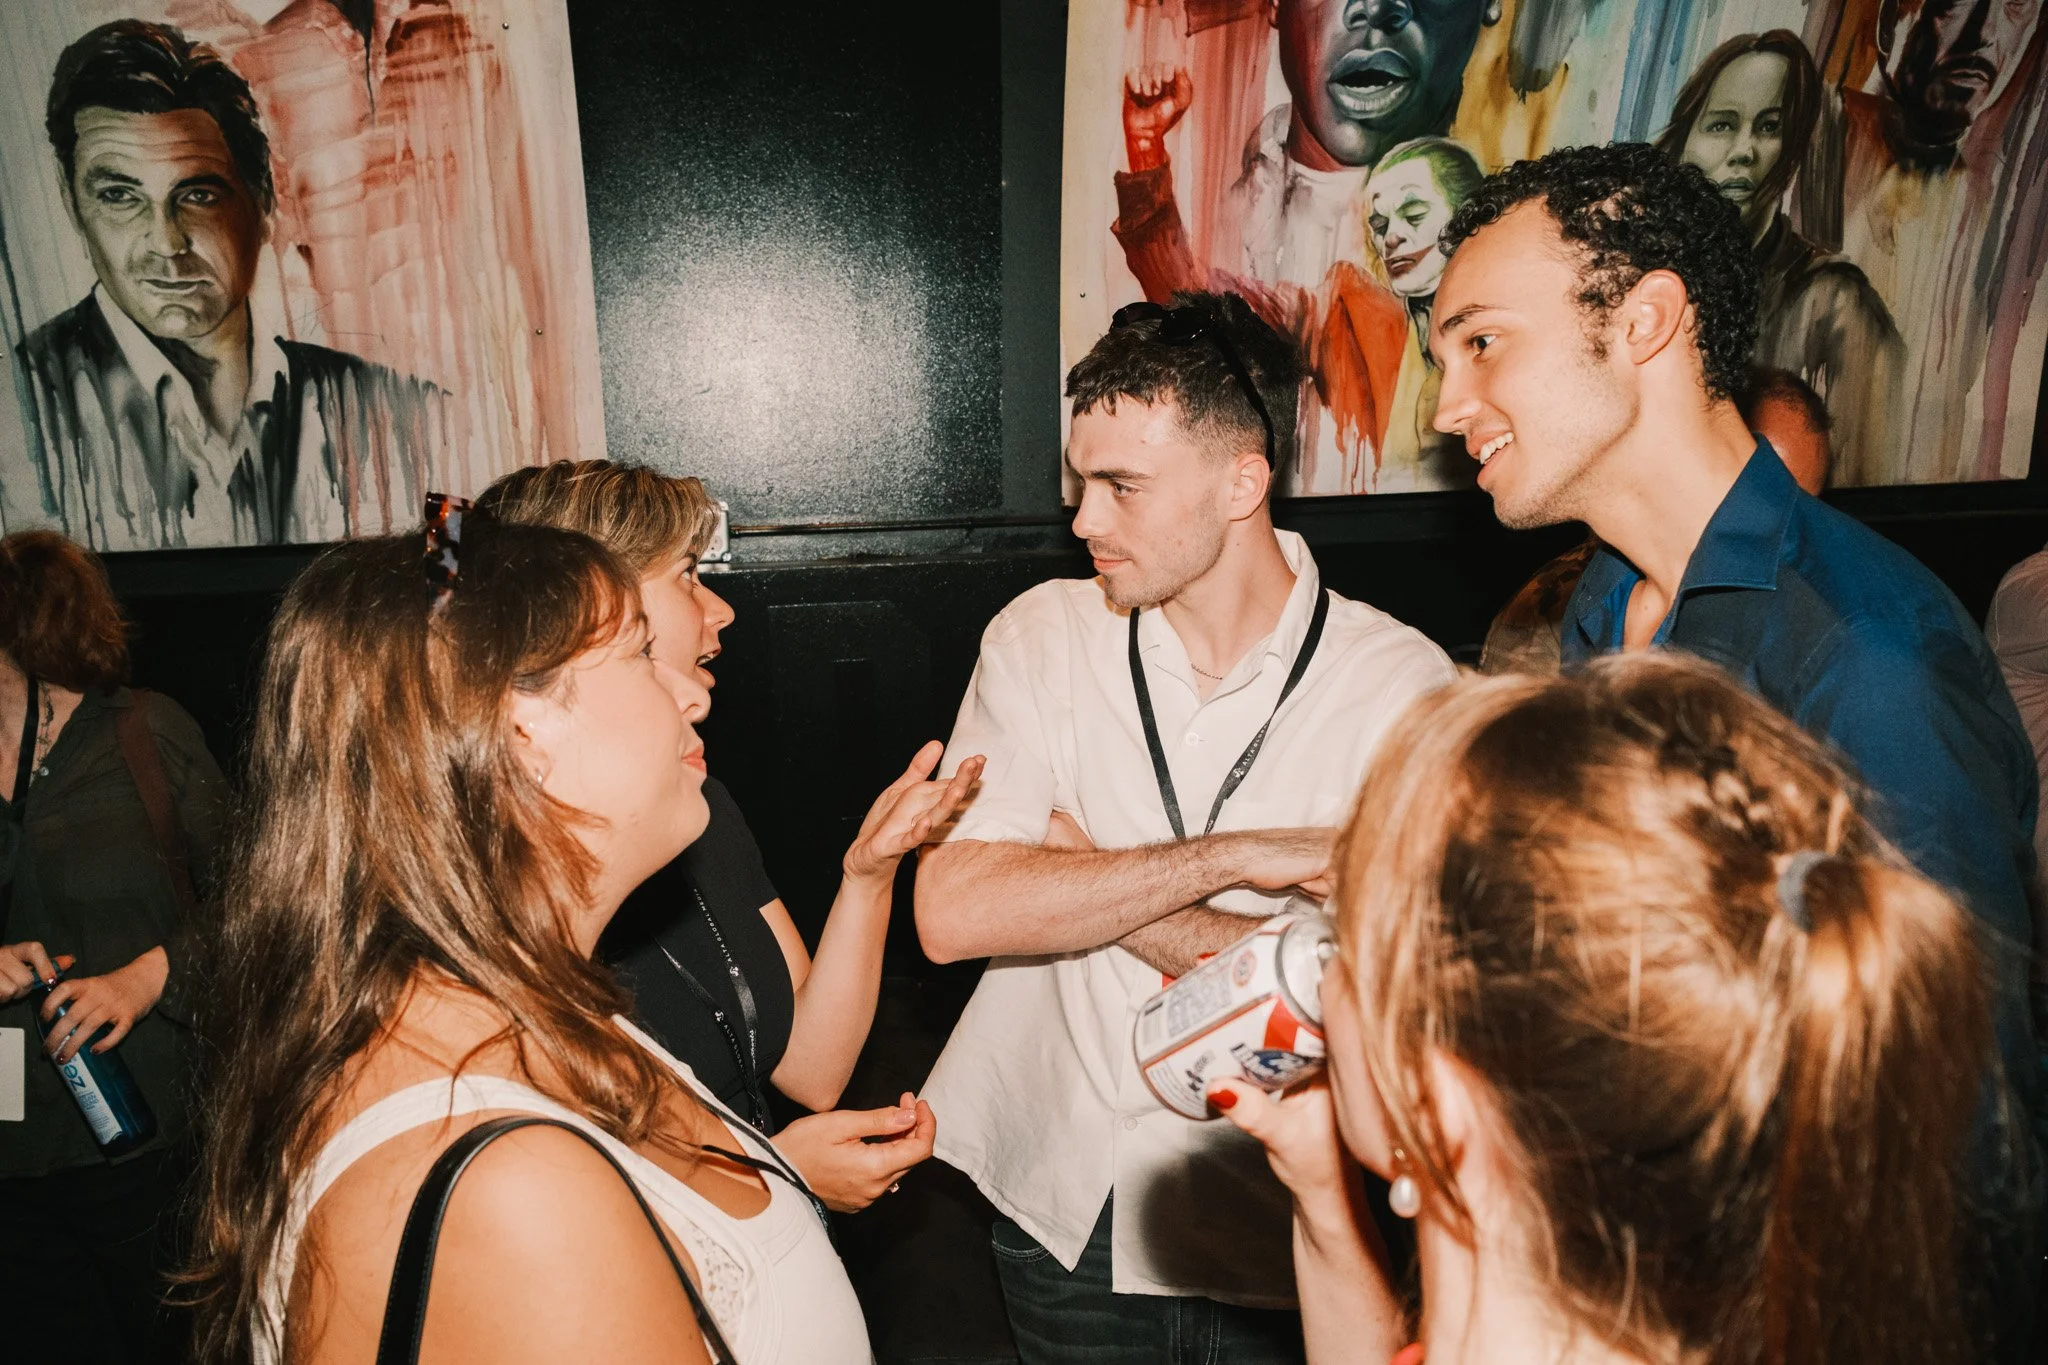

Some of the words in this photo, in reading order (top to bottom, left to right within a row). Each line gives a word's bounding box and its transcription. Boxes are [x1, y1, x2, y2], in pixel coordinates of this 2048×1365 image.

[1242, 749, 1256, 766] ALTA
[705, 913, 722, 942] GLOBAL
[720, 943, 733, 963] ALTA
[723, 1024, 735, 1044] ALTA
